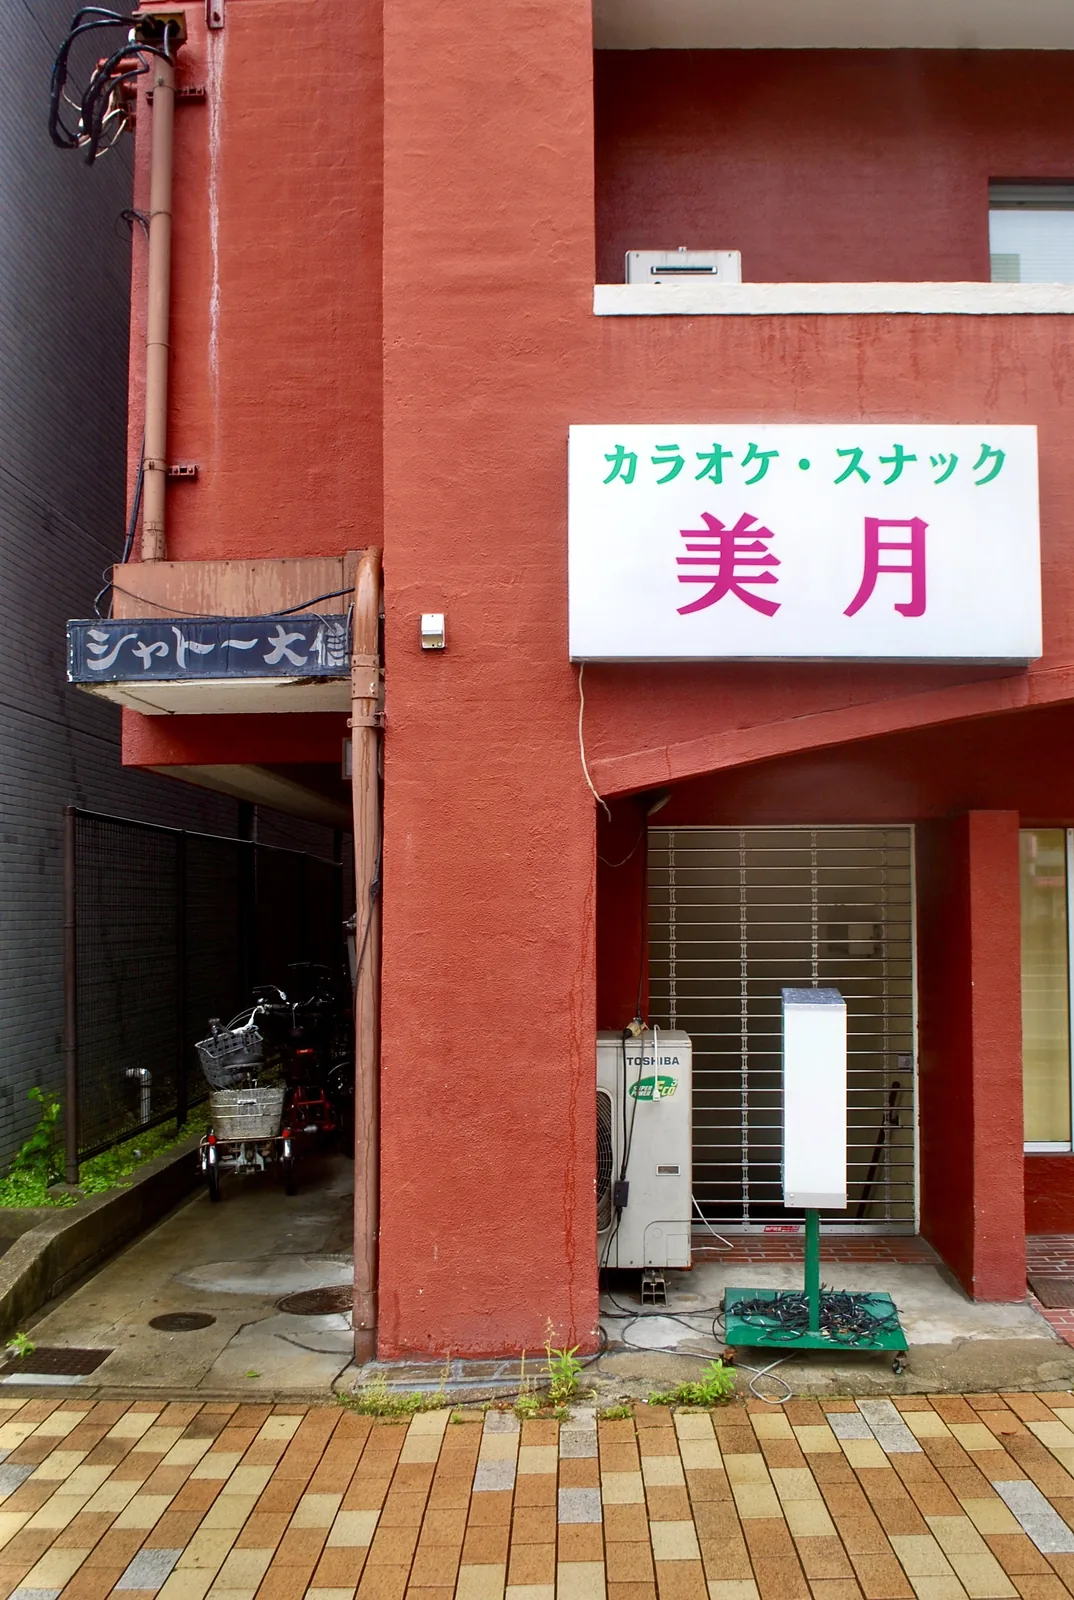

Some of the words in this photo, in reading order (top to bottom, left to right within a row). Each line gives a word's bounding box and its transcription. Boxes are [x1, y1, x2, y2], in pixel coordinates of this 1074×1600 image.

[604, 443, 1005, 485] カラオケ・スナック
[626, 1057, 679, 1065] TOSHIBA
